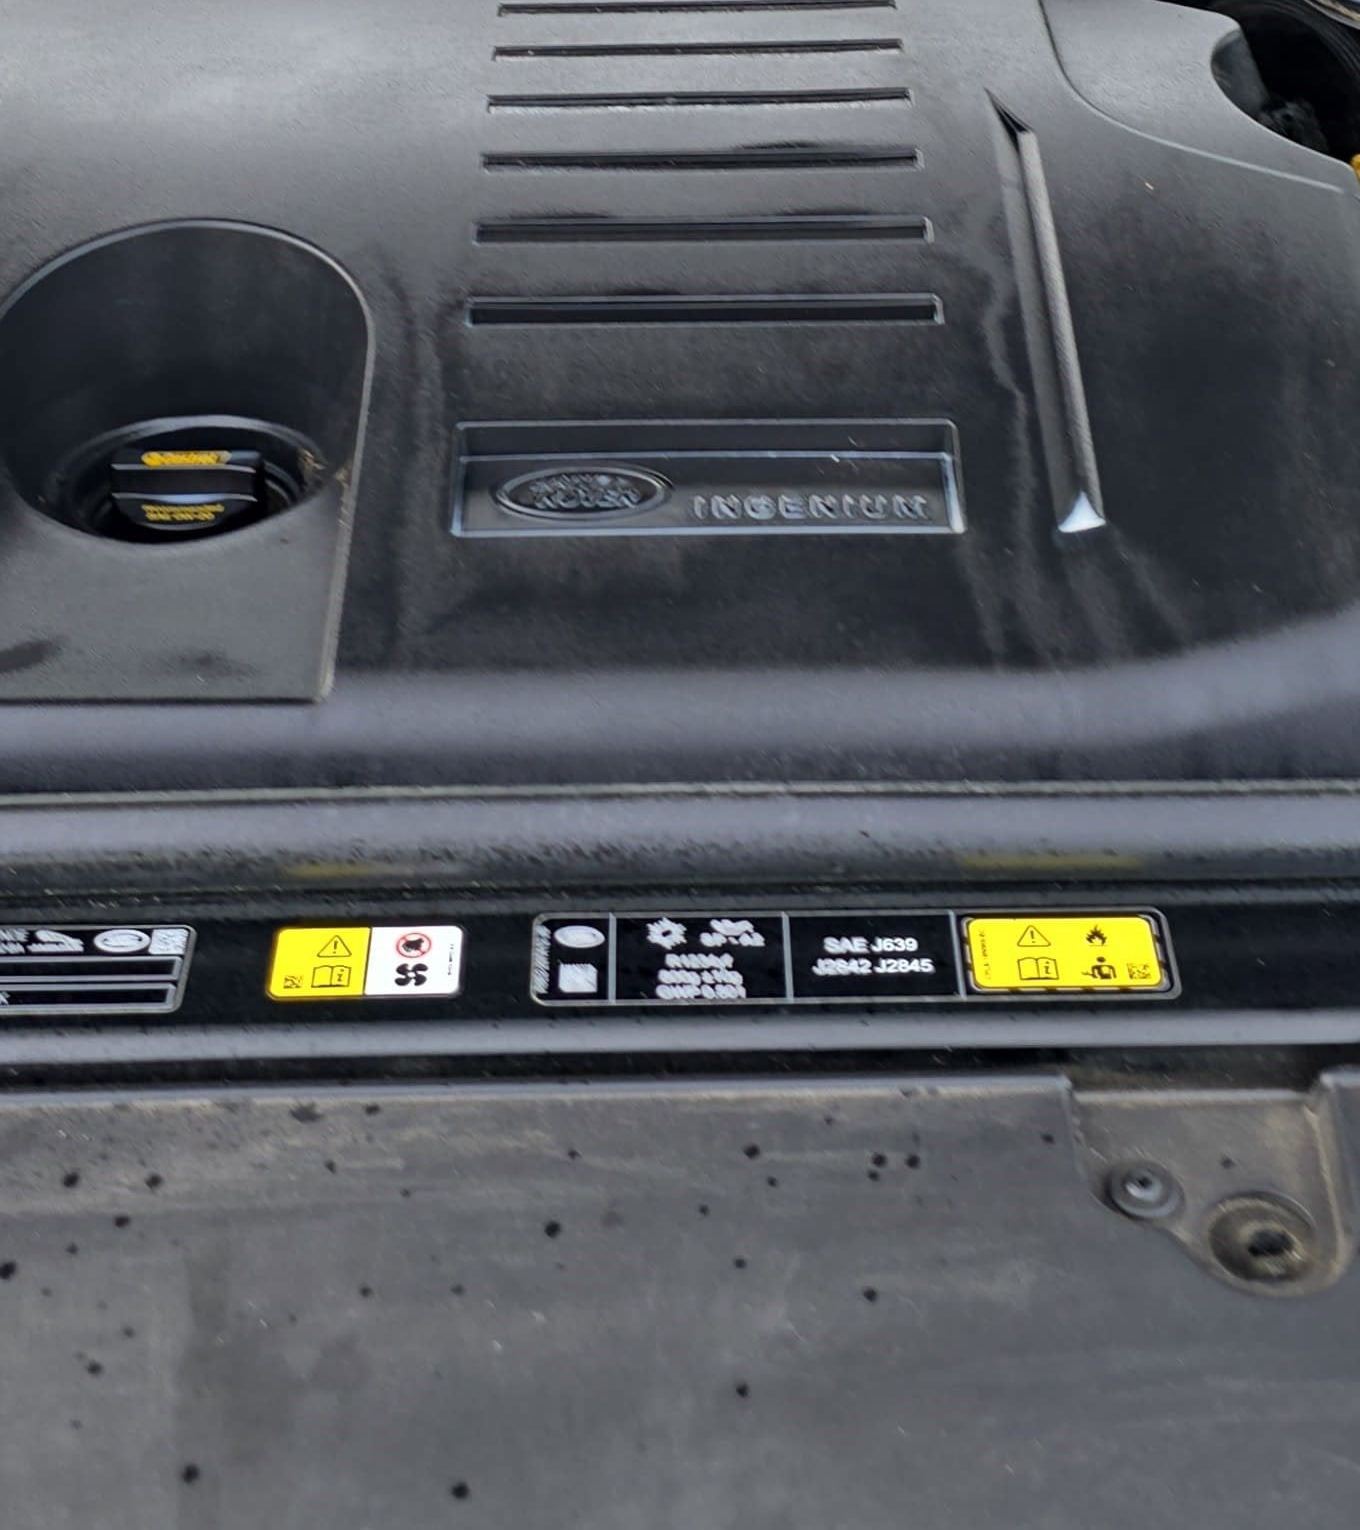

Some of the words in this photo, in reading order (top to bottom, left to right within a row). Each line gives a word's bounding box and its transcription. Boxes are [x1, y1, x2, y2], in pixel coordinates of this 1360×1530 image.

[693, 493, 930, 520] INGENIUM
[823, 936, 869, 954] SAE
[870, 936, 919, 953] J639
[812, 958, 872, 976] J2842
[873, 958, 934, 974] J2845
